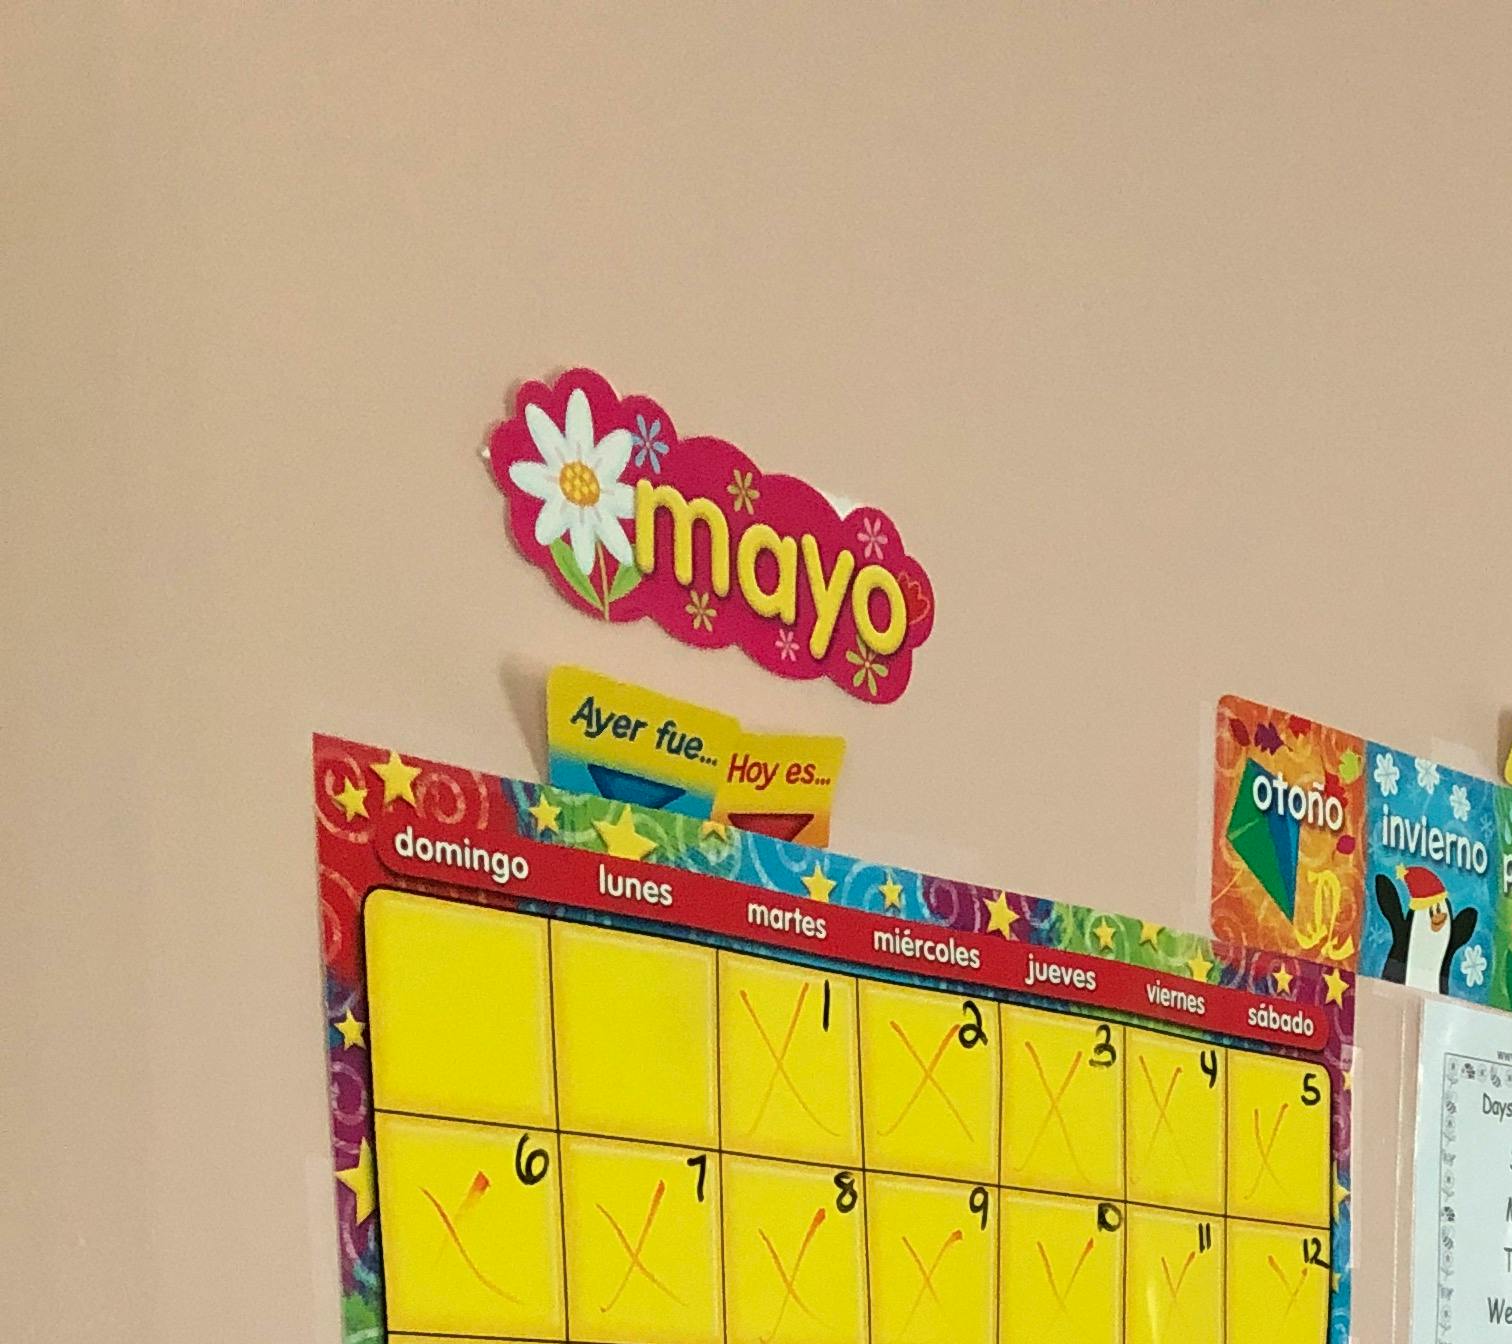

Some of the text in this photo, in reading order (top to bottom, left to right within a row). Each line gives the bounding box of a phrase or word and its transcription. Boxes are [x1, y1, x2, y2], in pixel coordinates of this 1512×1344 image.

[635, 479, 907, 660] mayo
[570, 697, 718, 767] Ayer fue...
[727, 753, 831, 790] Hoy es...
[1253, 773, 1344, 831] otoño
[394, 825, 529, 884] domingo
[1382, 805, 1488, 875] invierno
[599, 864, 673, 906] lunes
[747, 902, 828, 939] martes
[873, 927, 981, 969] miércoles
[1025, 954, 1097, 990] jueves
[822, 978, 830, 1033] 1
[1146, 981, 1206, 1014] viernes
[958, 1001, 988, 1049] 2
[1247, 1004, 1315, 1037] sábado
[1089, 1024, 1117, 1068] 3
[1200, 1049, 1218, 1089] 4
[1301, 1072, 1322, 1106] 5
[1482, 1093, 1512, 1123] Days
[515, 1133, 550, 1186] 6
[687, 1154, 707, 1202] 7
[833, 1171, 858, 1213] 8
[970, 1186, 989, 1231] 9
[1097, 1202, 1122, 1232] 10
[1198, 1222, 1212, 1253] 11
[1302, 1237, 1331, 1269] 12
